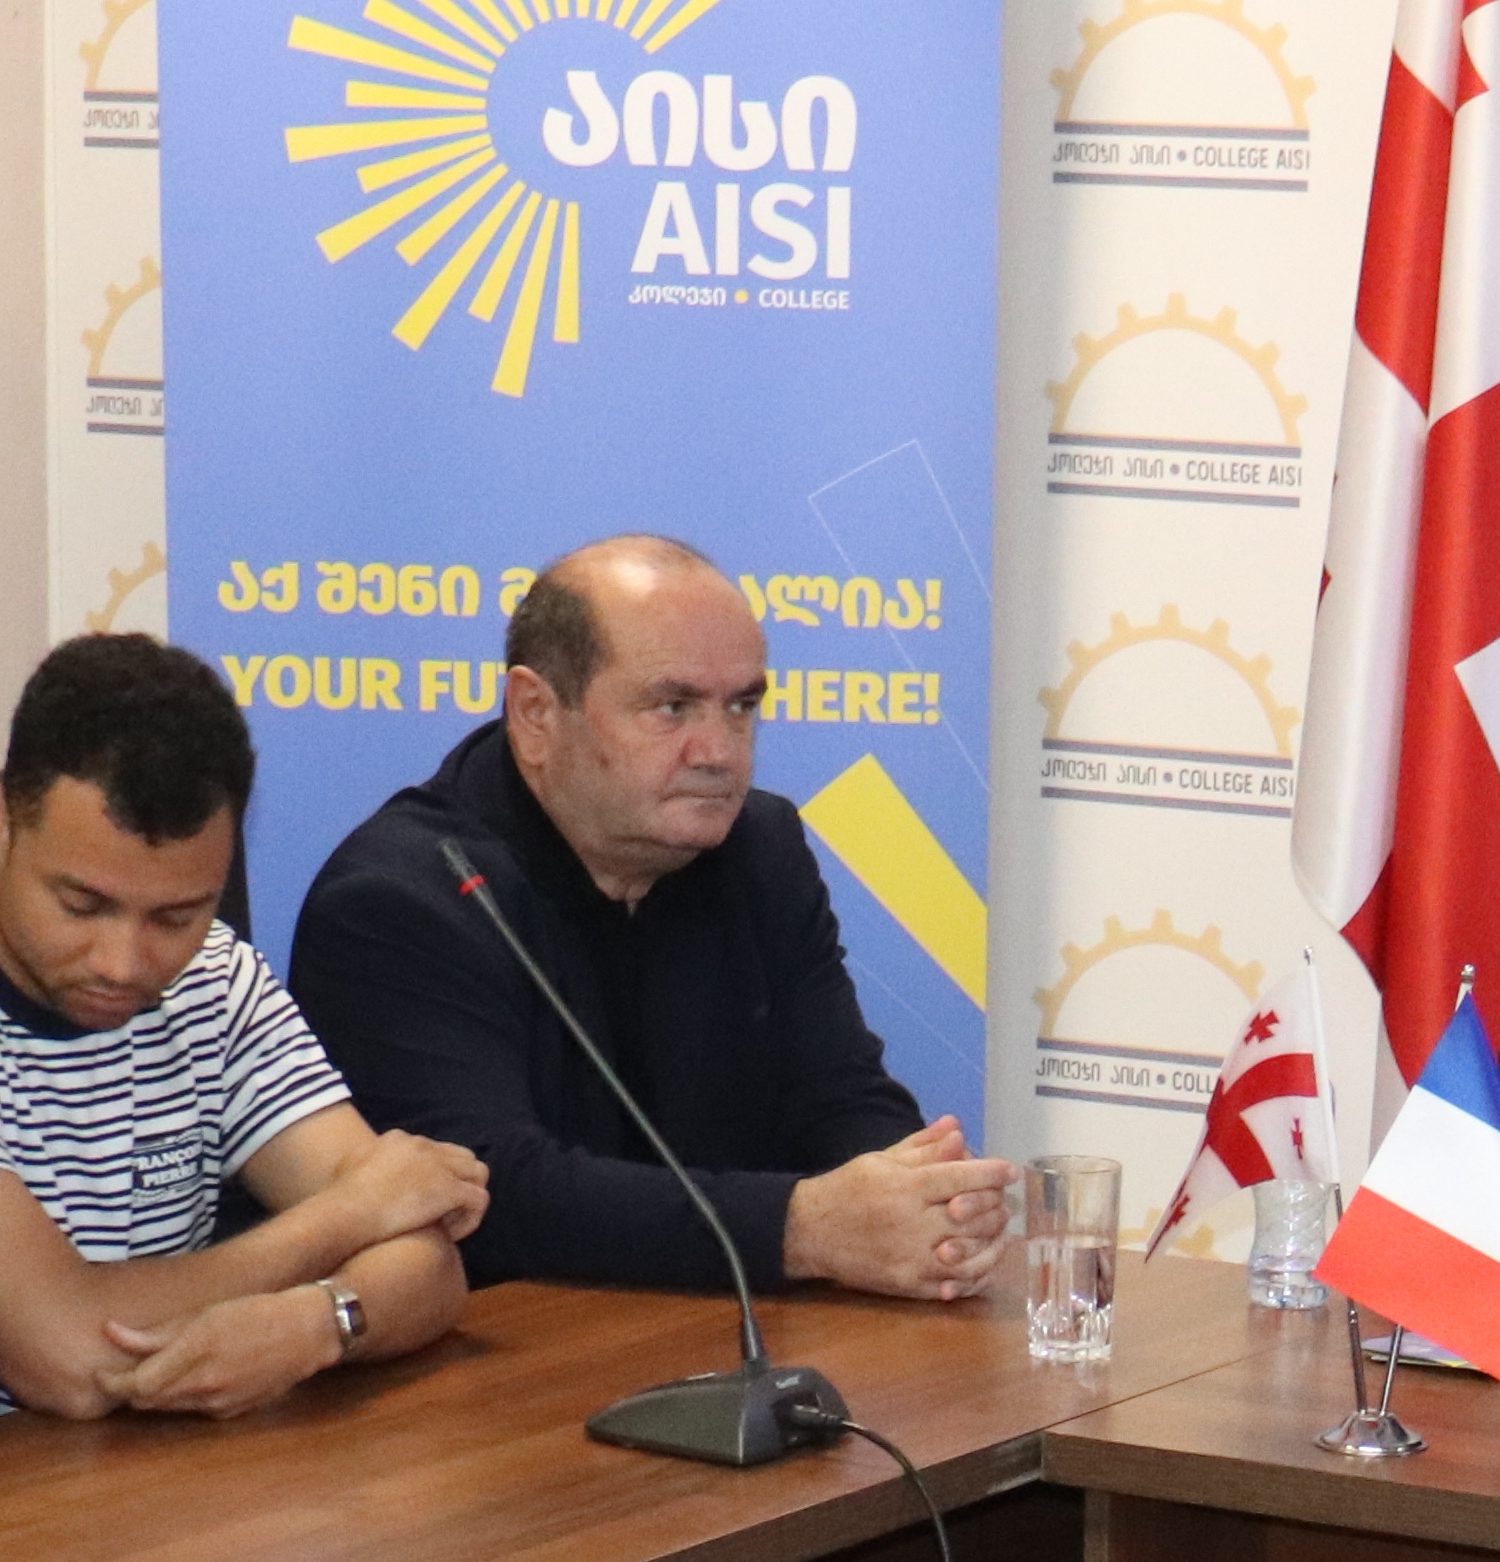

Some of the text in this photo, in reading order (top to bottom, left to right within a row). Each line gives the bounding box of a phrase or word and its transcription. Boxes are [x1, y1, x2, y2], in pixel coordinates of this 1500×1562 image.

[543, 70, 857, 171] აისი
[1052, 142, 1310, 170] კოლეჯი აისი COLLEGE AISI
[630, 181, 850, 281] AISI
[629, 285, 849, 310] კოლეჯი COLLEGE
[1047, 454, 1302, 487] კოლეჯი აისი COLLEGE AISI
[218, 561, 299, 613] აქ
[315, 561, 481, 617] შენი
[221, 655, 404, 710] YOUR
[760, 669, 940, 725] HERE!
[1041, 758, 1294, 798] კოლეჯი აისი COLLEGE AISI
[1036, 1057, 1214, 1093] კოლეჯი აისი COLL
